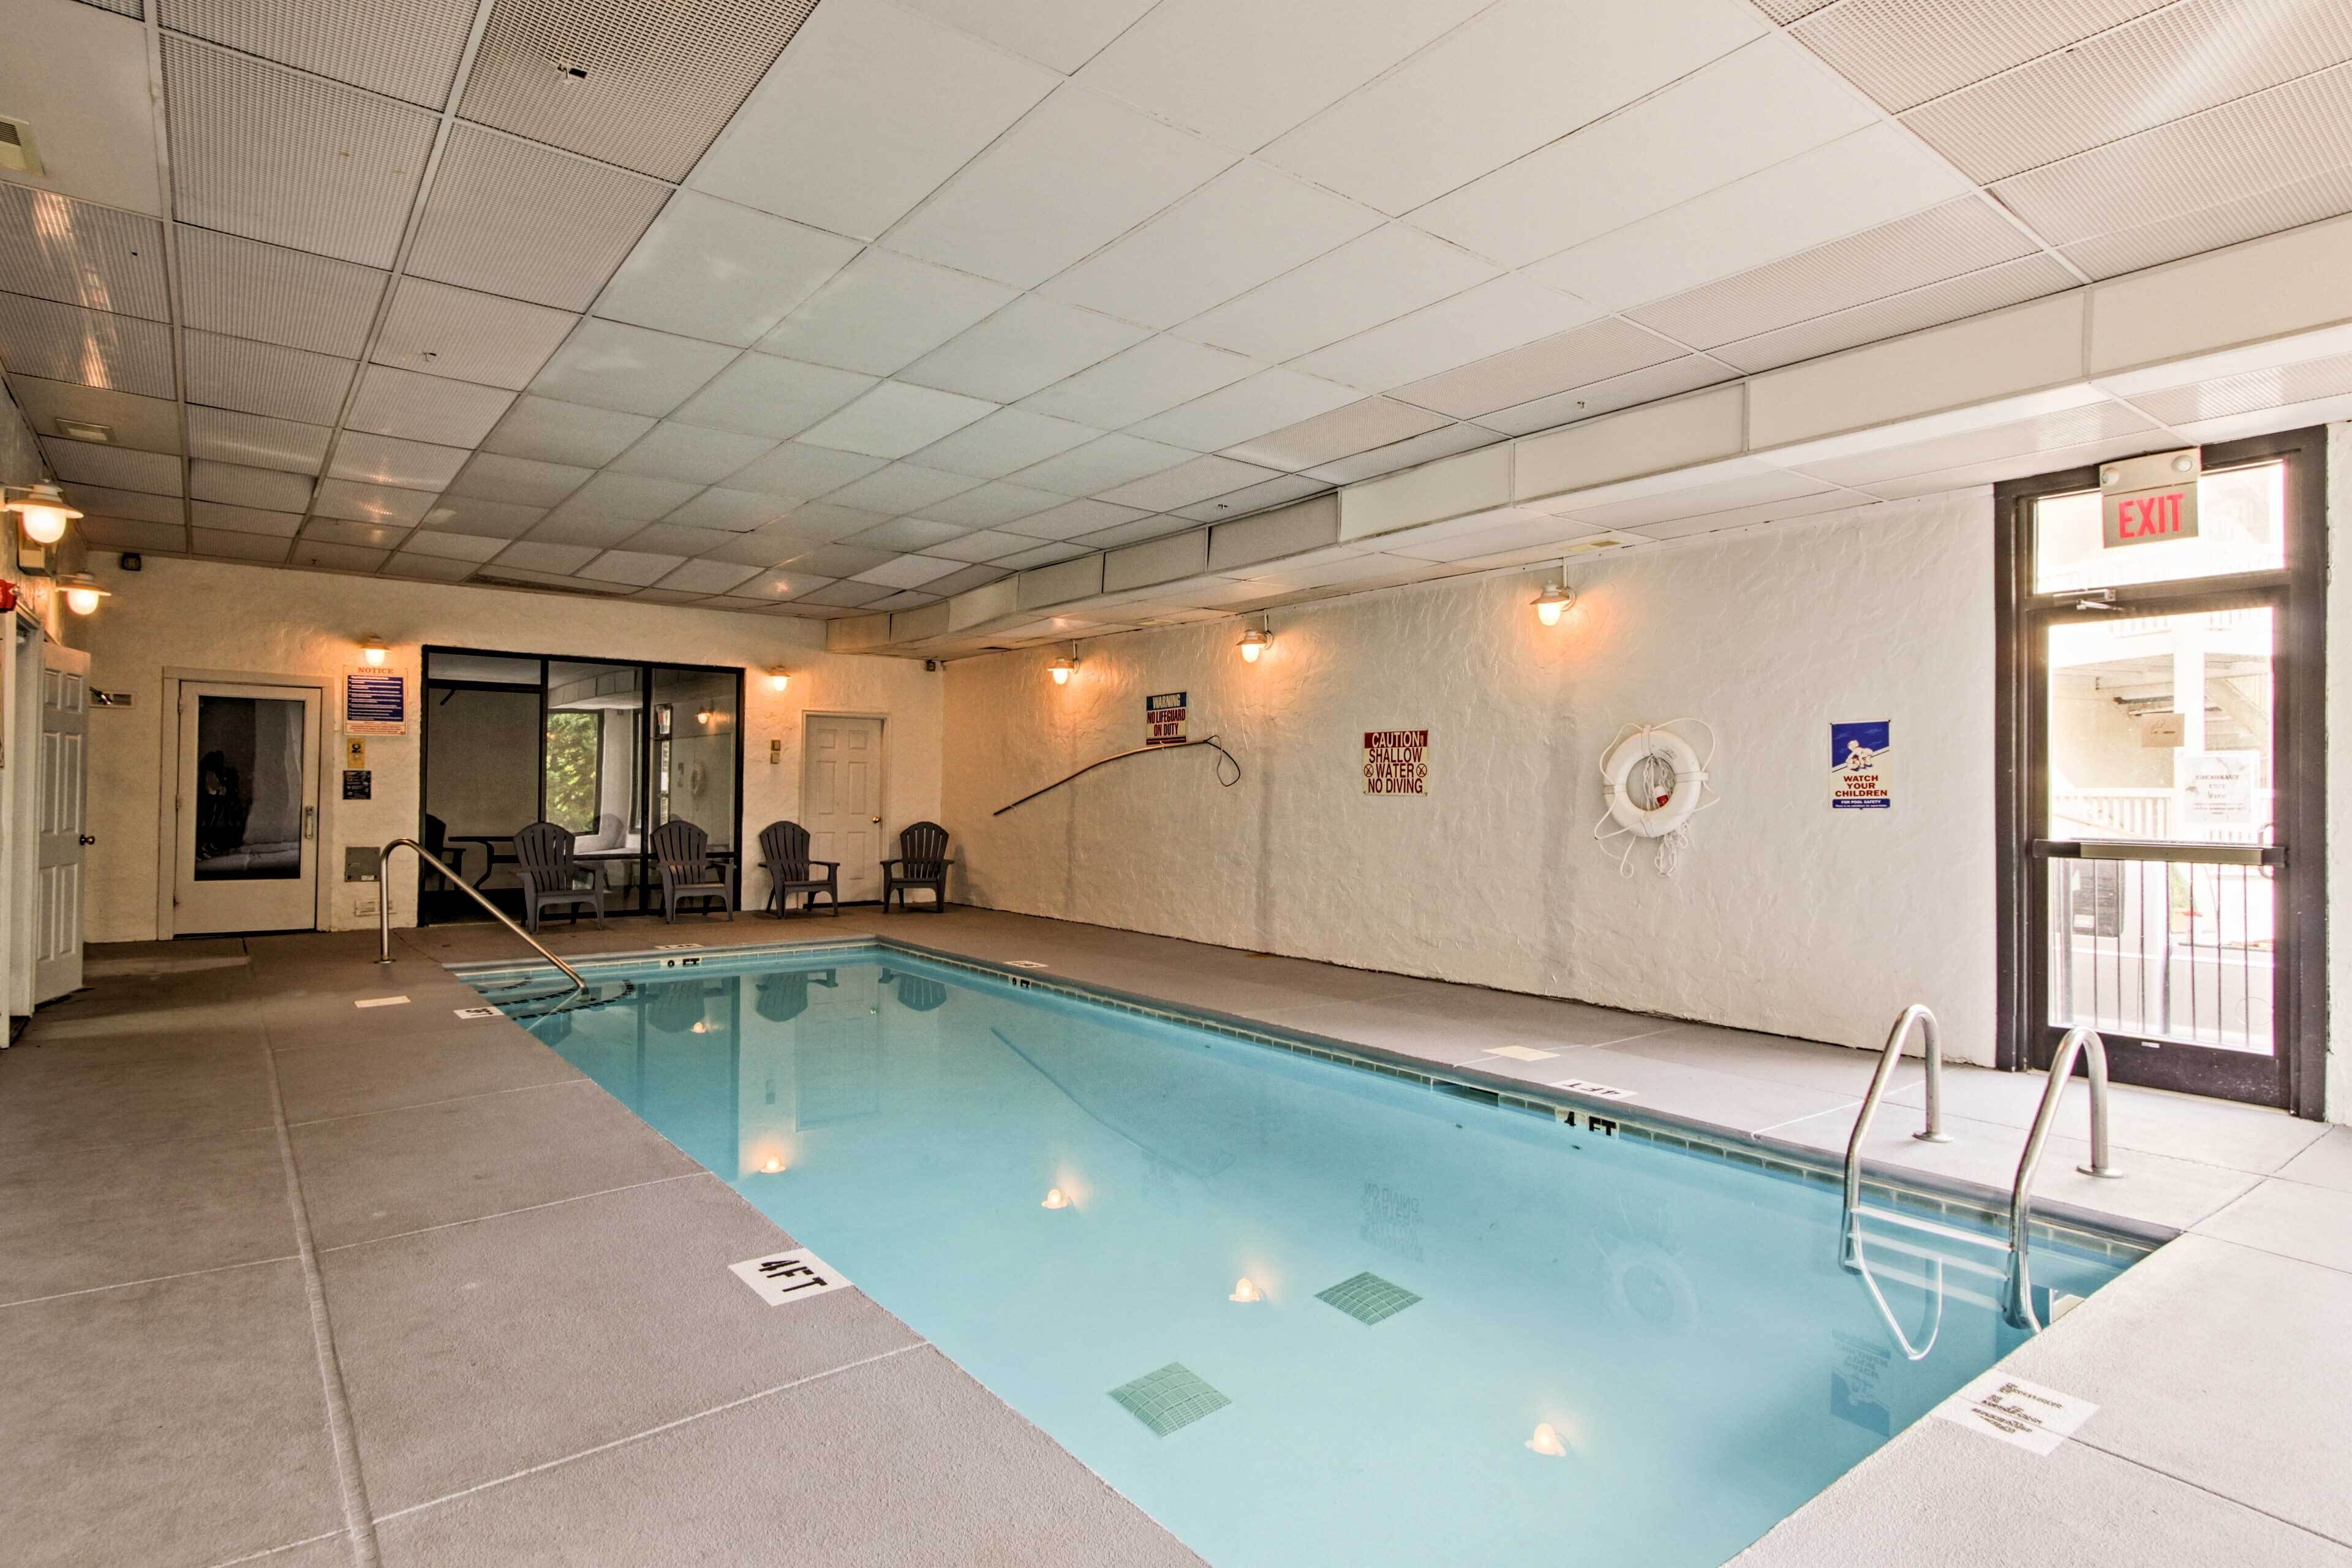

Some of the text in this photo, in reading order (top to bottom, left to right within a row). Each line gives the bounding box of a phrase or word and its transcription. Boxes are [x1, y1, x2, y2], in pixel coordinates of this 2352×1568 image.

[2119, 492, 2184, 539] EXIT
[1153, 694, 1180, 709] WARNING
[1147, 708, 1186, 724] NO LIFEGUARD
[1154, 723, 1178, 736] ON DUTY
[1372, 731, 1420, 748] CAUTION
[1369, 747, 1422, 763] SHALLOW
[1376, 763, 1414, 778] WATER
[1368, 778, 1423, 793] NO DIVING
